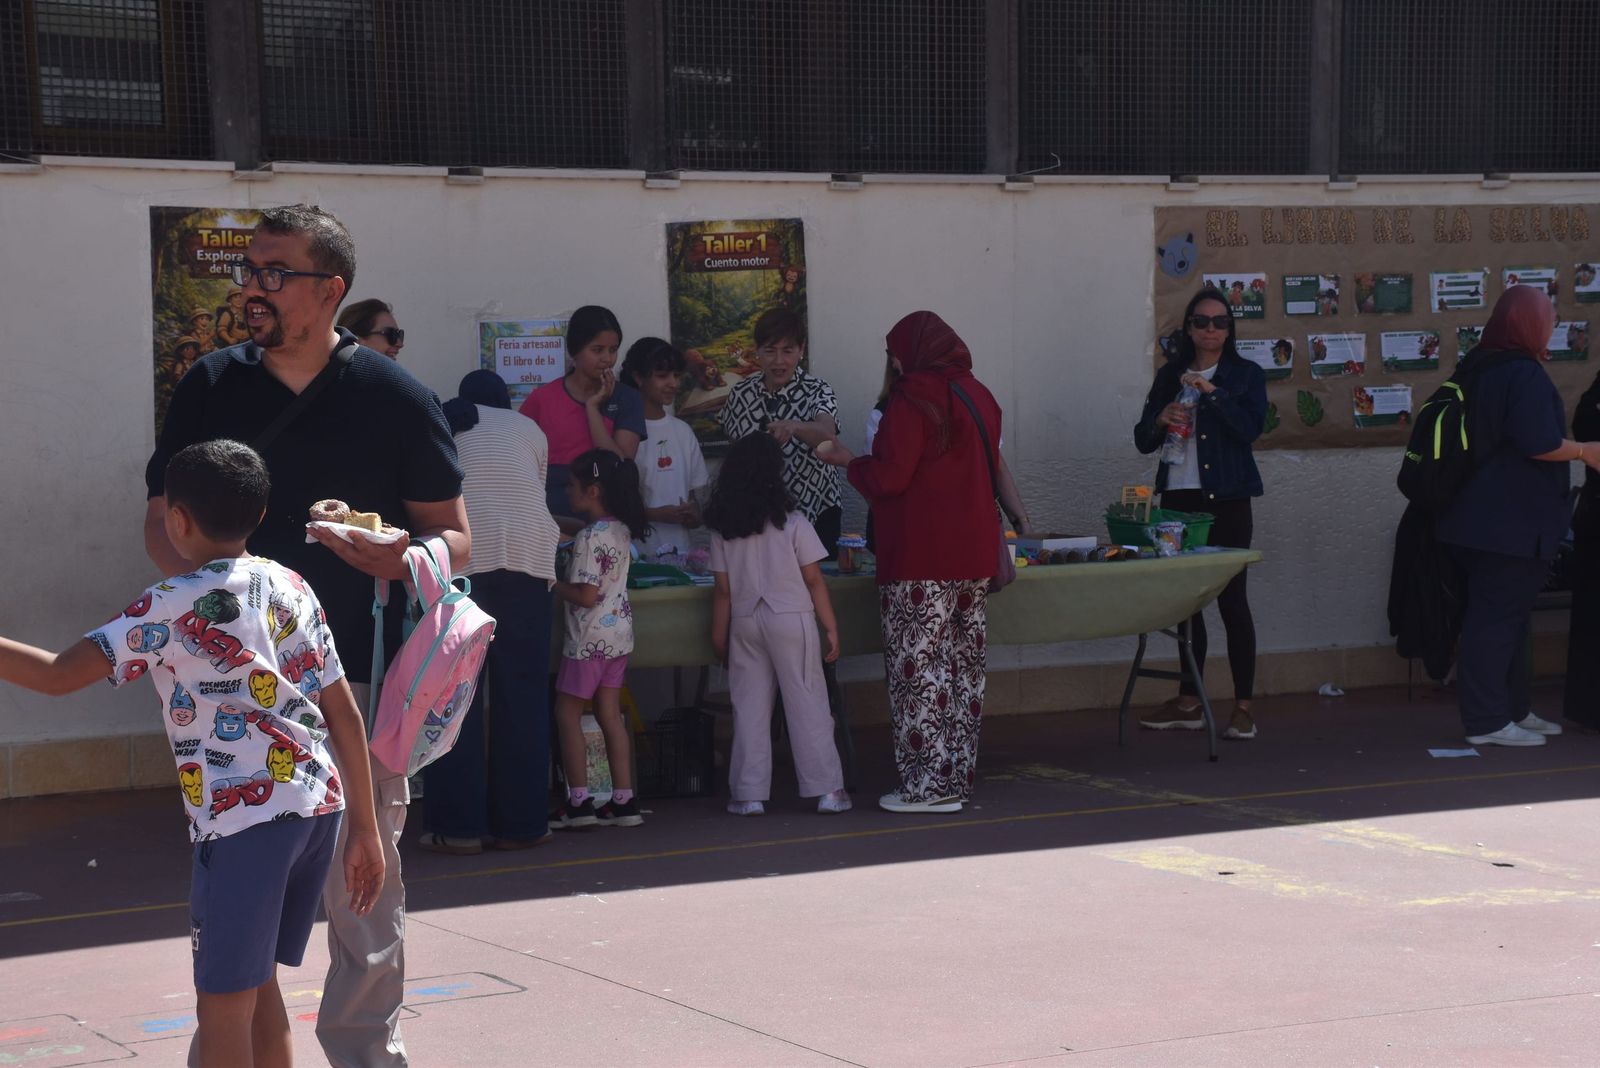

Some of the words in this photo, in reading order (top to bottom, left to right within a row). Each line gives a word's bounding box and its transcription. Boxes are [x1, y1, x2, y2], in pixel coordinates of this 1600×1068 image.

[1206, 209, 1249, 248] EL
[1262, 207, 1357, 245] LIBRO
[1373, 207, 1415, 245] DE
[1433, 207, 1472, 244] LA
[1489, 206, 1590, 243] SELVA
[198, 229, 253, 248] Taller
[702, 234, 754, 254] Taller
[756, 233, 767, 253] 1
[704, 257, 739, 268] Cuento
[740, 256, 770, 267] motor
[209, 263, 221, 274] de
[223, 263, 232, 274] la
[498, 339, 520, 349] Feria
[522, 338, 561, 349] artesanal
[503, 356, 511, 366] El
[513, 355, 532, 366] libro
[535, 355, 546, 366] de
[548, 354, 555, 365] la
[520, 372, 542, 383] selva
[198, 678, 243, 688] AVENGERS
